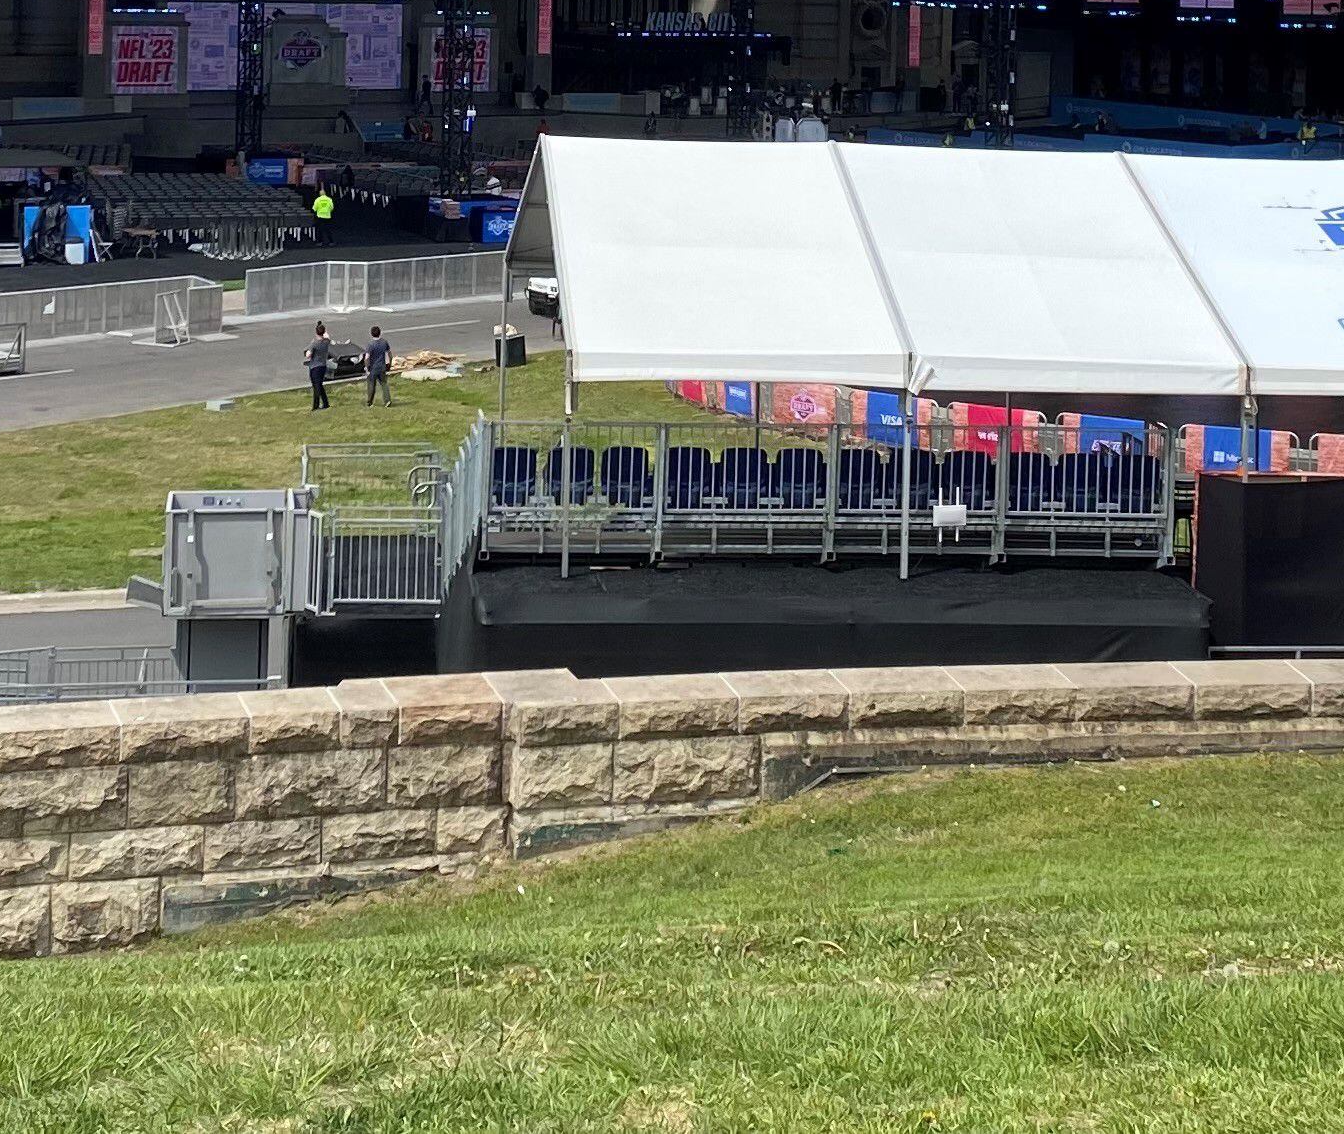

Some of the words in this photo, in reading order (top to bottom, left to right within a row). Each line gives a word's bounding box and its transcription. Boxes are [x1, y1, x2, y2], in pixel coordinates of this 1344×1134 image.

[118, 39, 146, 59] NFL
[150, 39, 174, 59] '23
[116, 61, 174, 83] DRAFT
[880, 413, 903, 426] VISA
